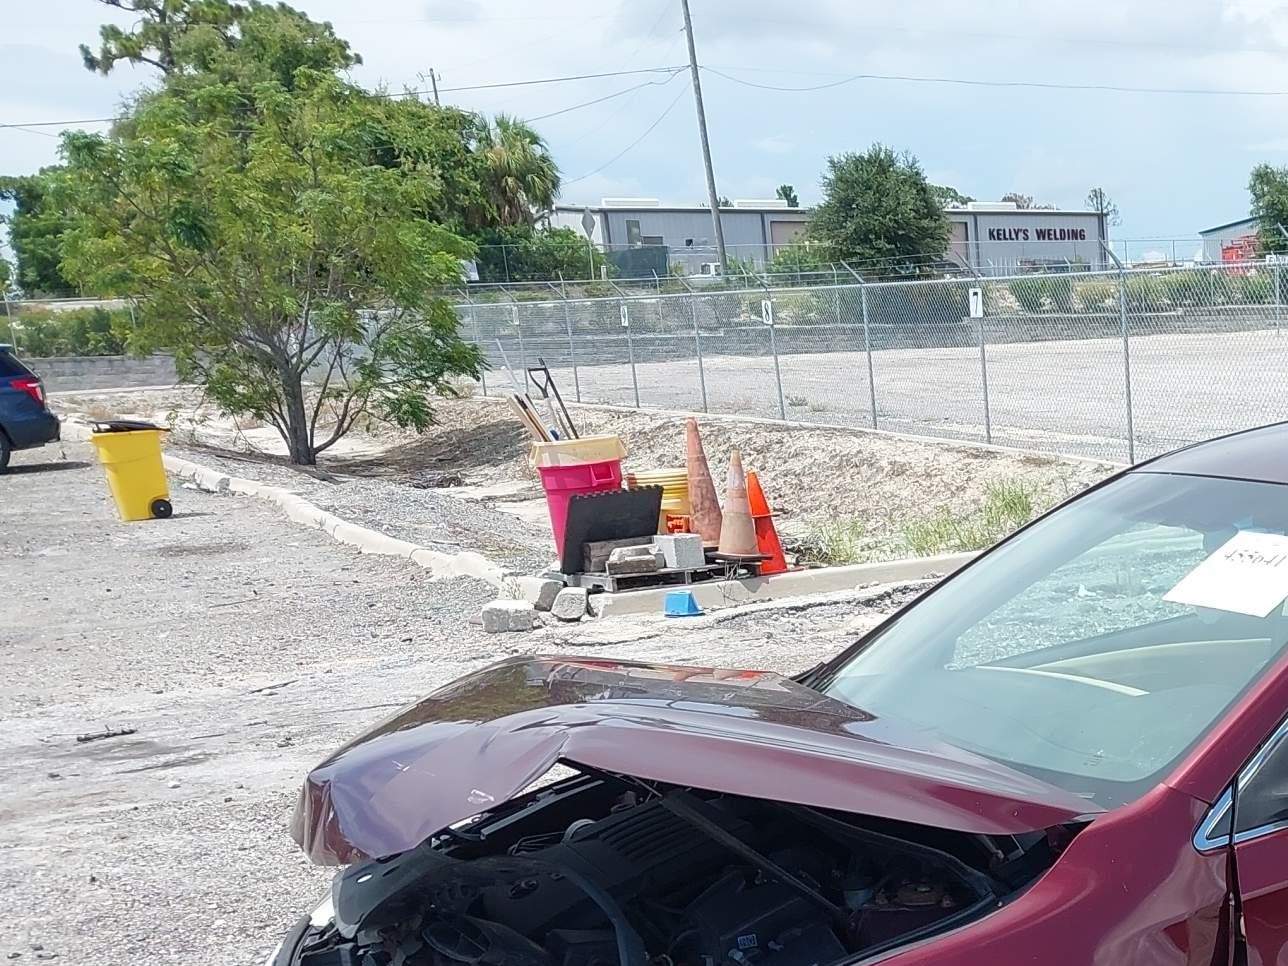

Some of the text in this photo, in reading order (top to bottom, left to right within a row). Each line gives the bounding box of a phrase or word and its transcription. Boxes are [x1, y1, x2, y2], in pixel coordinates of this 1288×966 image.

[988, 228, 1086, 241] KELLY'S WELDING
[764, 303, 770, 321] 8
[973, 291, 979, 315] 7
